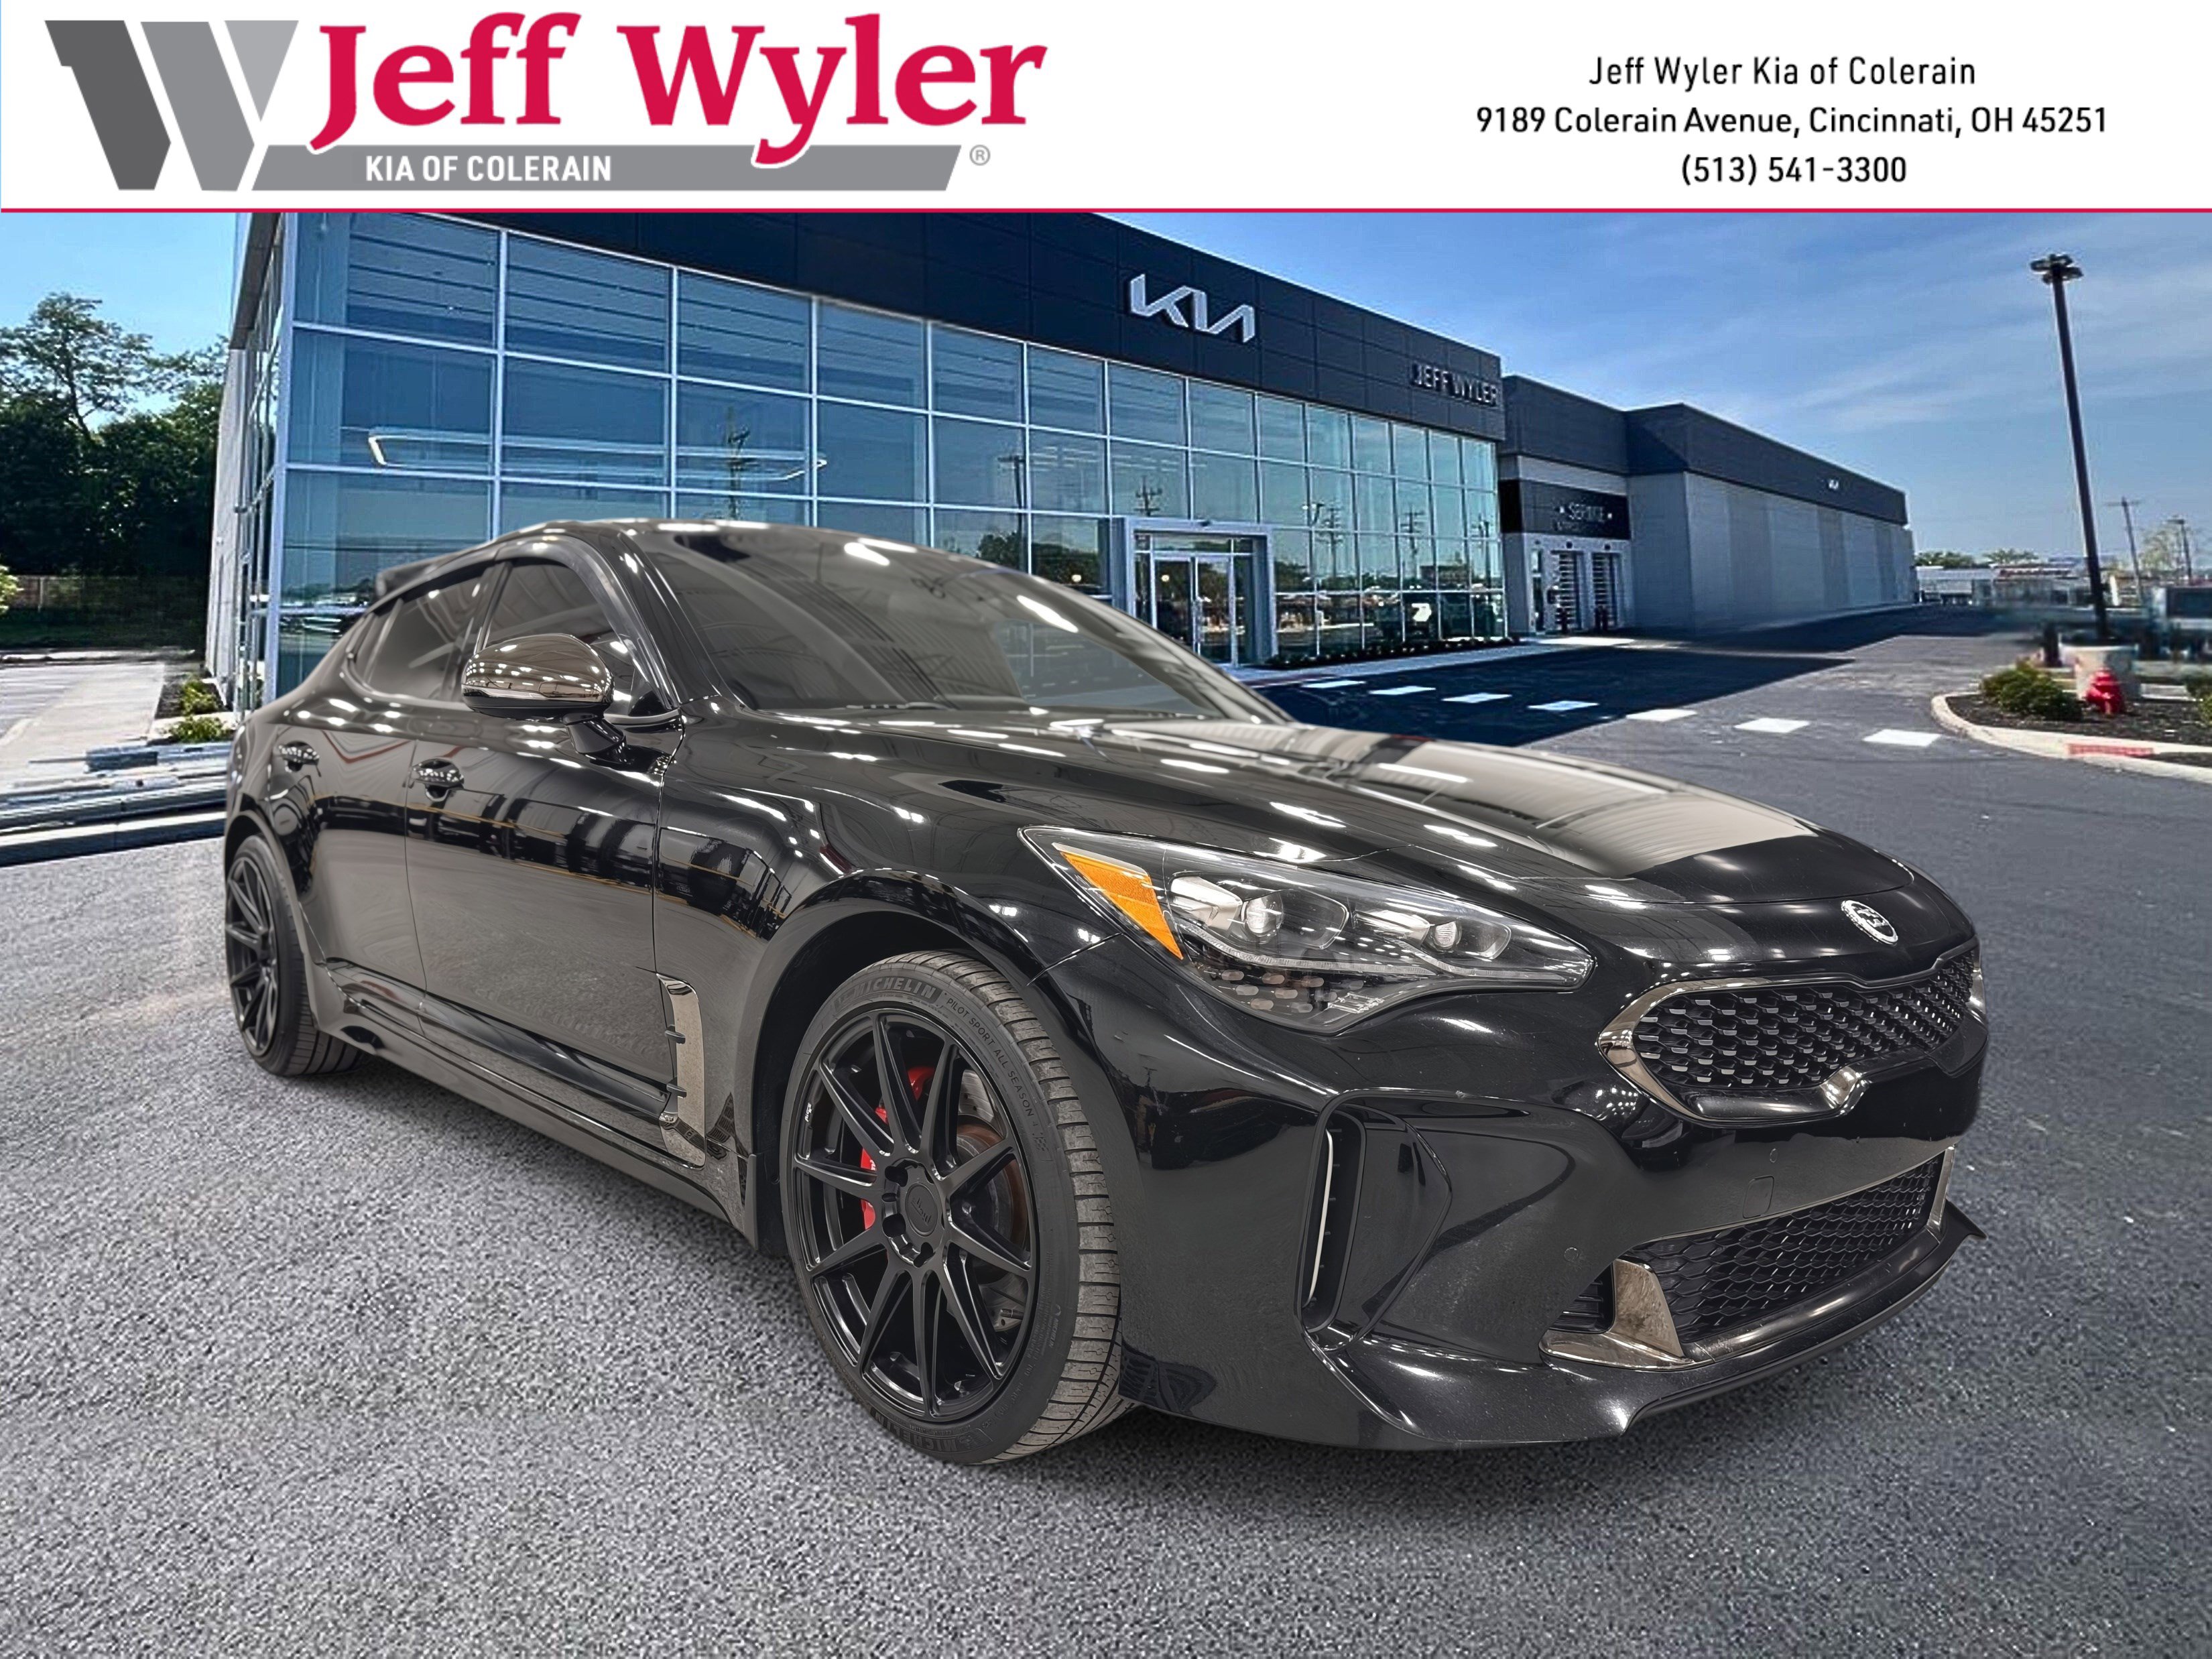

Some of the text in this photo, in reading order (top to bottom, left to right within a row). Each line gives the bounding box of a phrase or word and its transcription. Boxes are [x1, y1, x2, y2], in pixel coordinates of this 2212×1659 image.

[1131, 273, 1255, 343] KIA
[1414, 363, 1499, 405] JEFF WYLER
[852, 976, 936, 999] MICHELIN
[946, 998, 970, 1018] PILOT
[969, 1017, 995, 1046] SPORT
[993, 1049, 1008, 1067] ALL
[1007, 1070, 1034, 1116] SEASON
